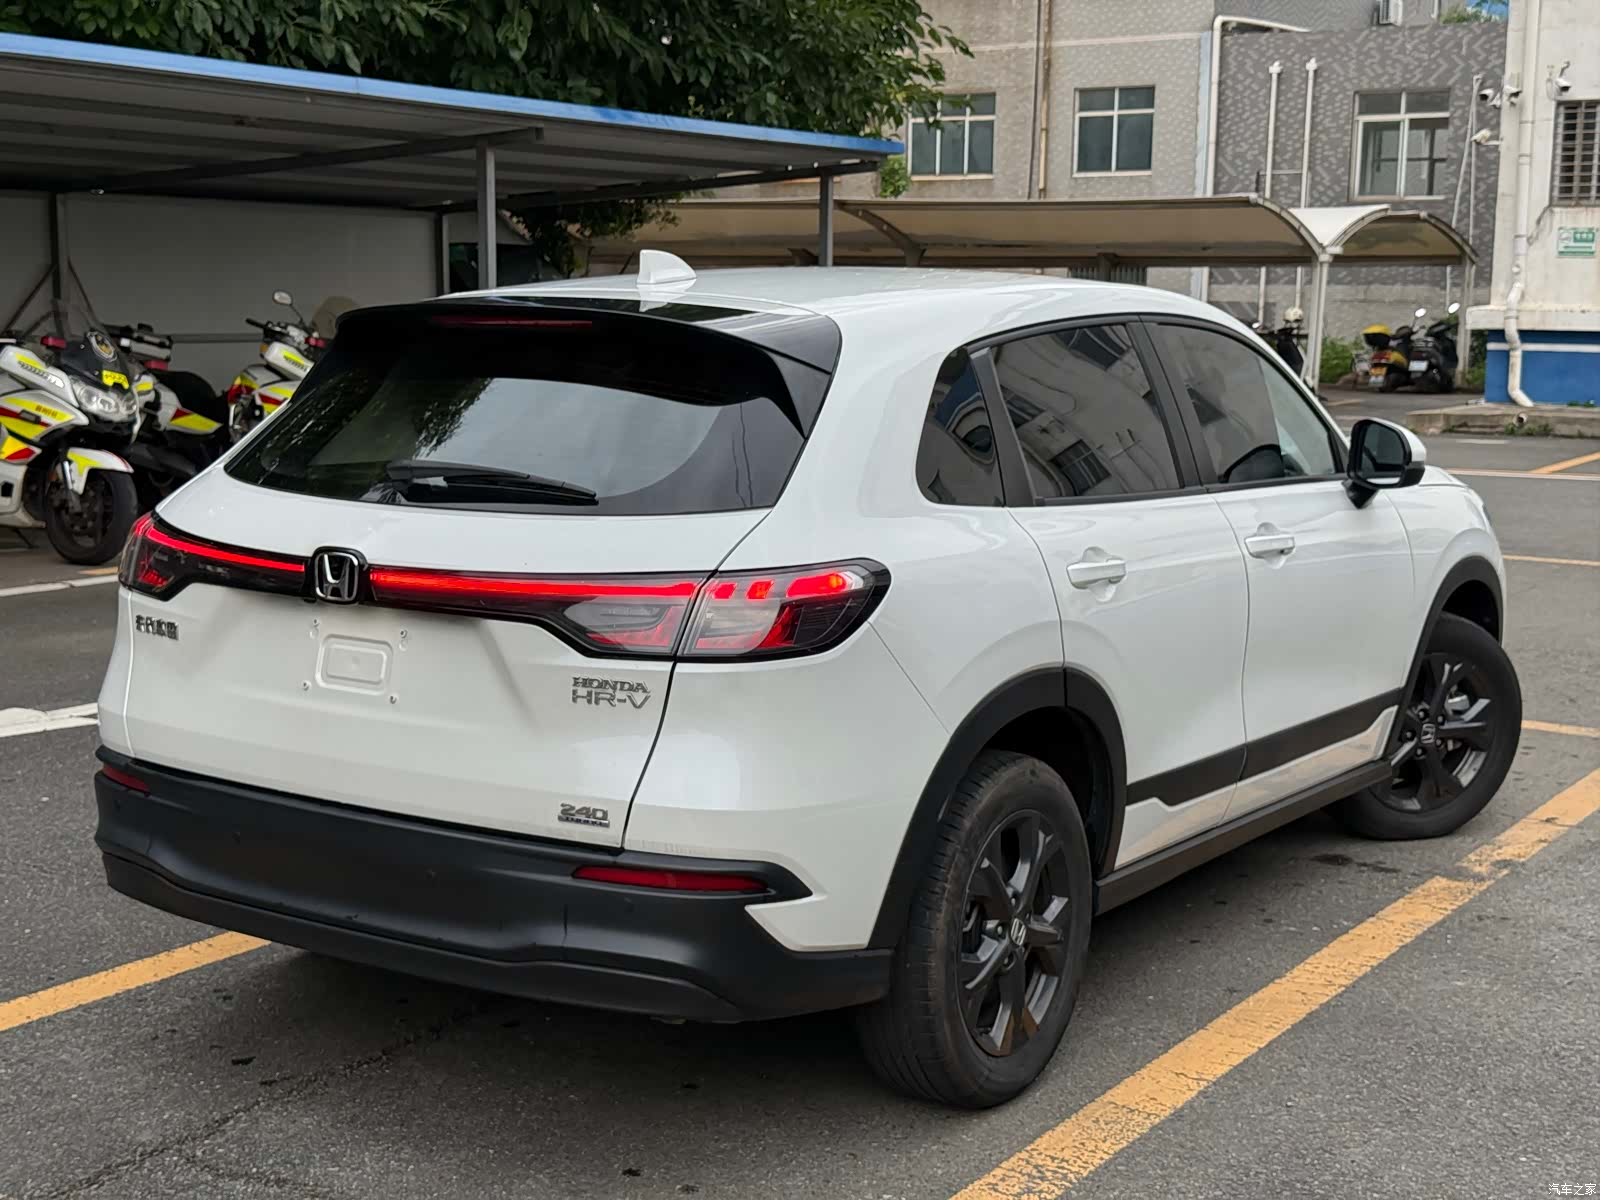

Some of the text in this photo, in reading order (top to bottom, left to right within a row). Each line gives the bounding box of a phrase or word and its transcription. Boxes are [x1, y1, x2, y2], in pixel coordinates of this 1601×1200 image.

[572, 677, 651, 693] HONDA
[571, 688, 651, 709] HR-V
[560, 803, 608, 820] 240
